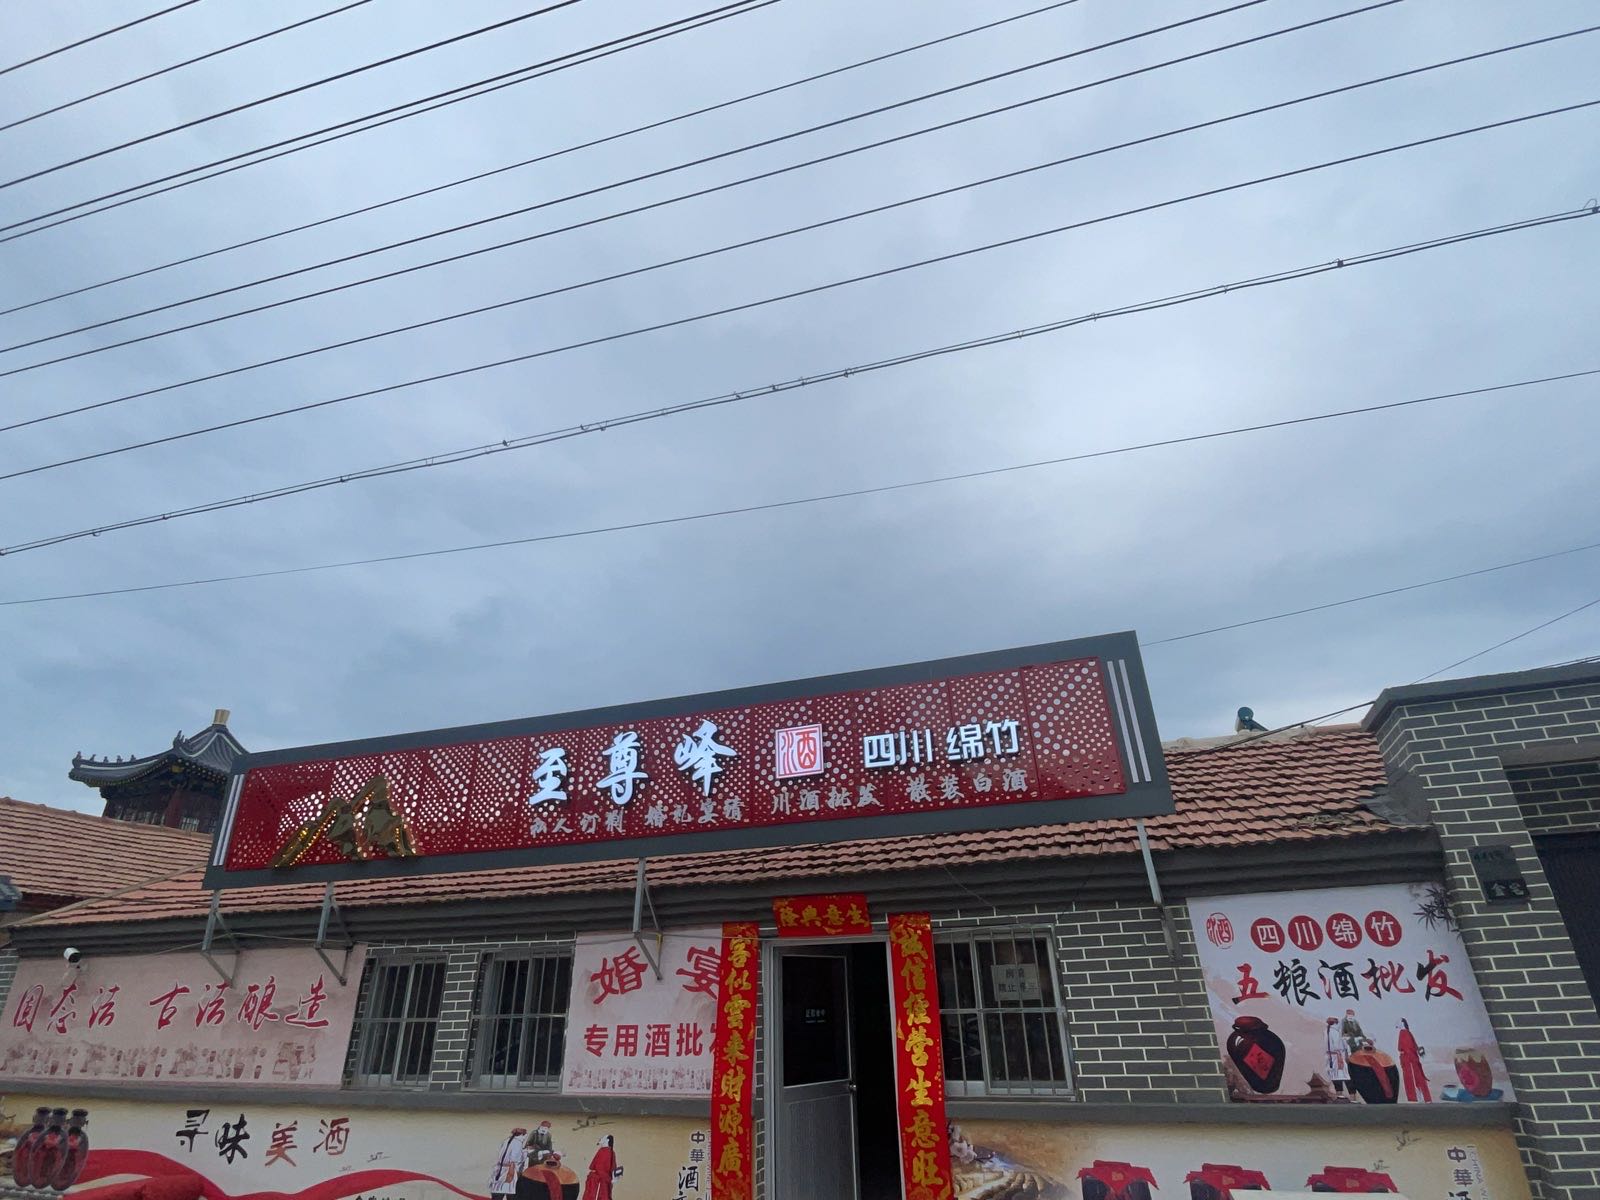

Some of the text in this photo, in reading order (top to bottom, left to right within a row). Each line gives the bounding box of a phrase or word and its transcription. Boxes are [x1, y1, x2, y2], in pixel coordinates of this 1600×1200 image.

[529, 718, 738, 805] 至尊峰
[1253, 912, 1399, 949] 四川绵竹
[1231, 949, 1464, 1007] 五粮酒批发
[583, 1022, 717, 1058] 专用酒批
[175, 1108, 351, 1168] 寻味美酒
